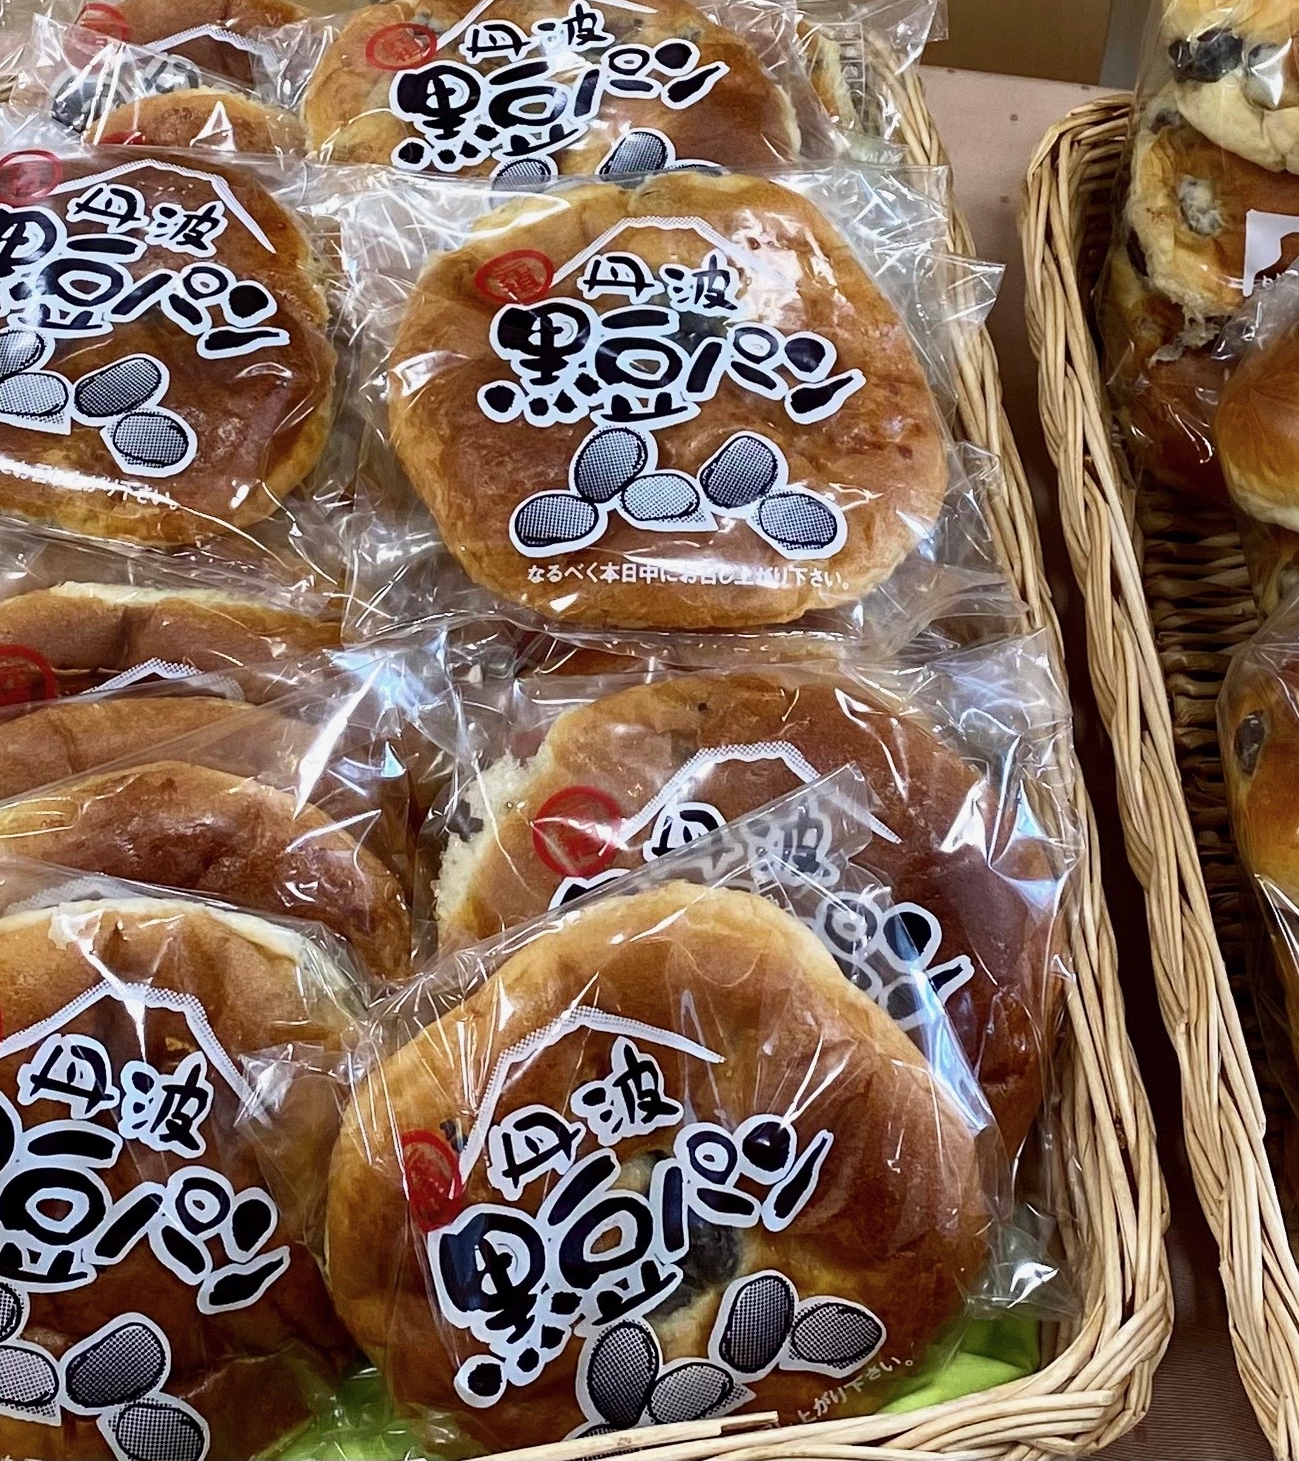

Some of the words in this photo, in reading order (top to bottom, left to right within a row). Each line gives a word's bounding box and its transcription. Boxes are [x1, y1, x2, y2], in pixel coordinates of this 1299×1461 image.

[390, 38, 730, 173] 黒豆パン
[68, 183, 228, 257] 丹波
[582, 251, 742, 313] 丹波
[478, 297, 867, 429] 黒豆パン
[17, 1033, 215, 1157] 丹波
[487, 1037, 684, 1200] 丹波
[454, 1114, 834, 1406] 黒豆パン
